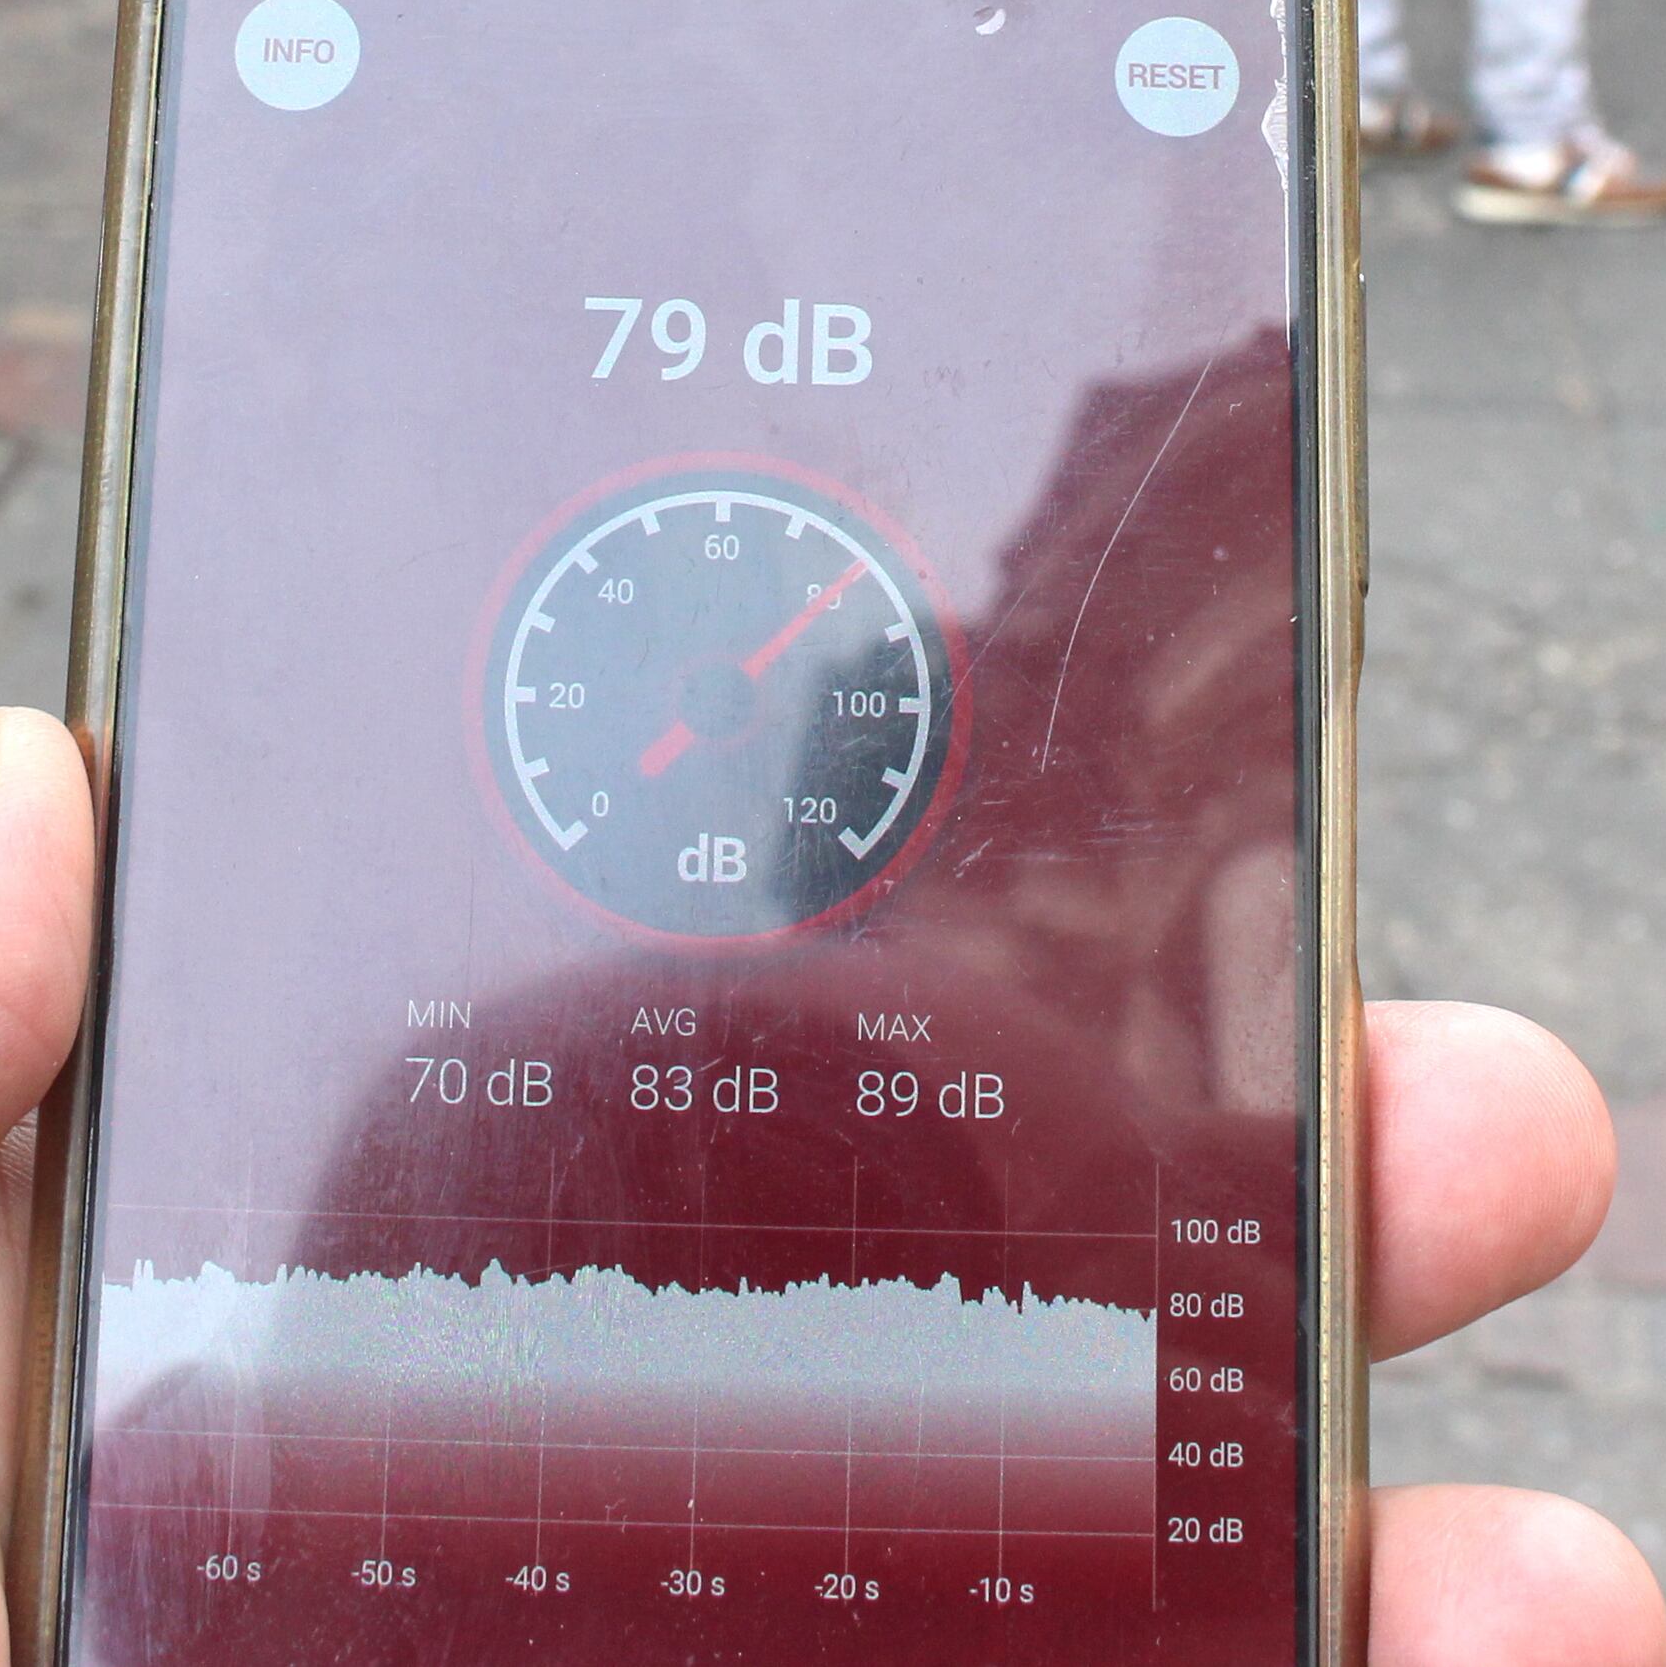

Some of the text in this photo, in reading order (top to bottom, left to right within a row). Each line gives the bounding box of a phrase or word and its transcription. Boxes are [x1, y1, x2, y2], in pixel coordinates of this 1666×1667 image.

[263, 37, 335, 65] INFO
[1127, 62, 1226, 90] RESET
[583, 296, 874, 387] 79 dB
[703, 534, 741, 561] 60
[597, 577, 635, 606] 40
[547, 682, 586, 710] 20
[831, 690, 887, 719] 100
[590, 791, 610, 818] 0
[782, 796, 838, 824] 120
[677, 833, 748, 884] dB
[406, 999, 472, 1030] MIN
[630, 1006, 697, 1037] AVG
[856, 1012, 932, 1043] MAX
[404, 1056, 555, 1107] 70 dB
[630, 1063, 779, 1114] 83 dB
[854, 1069, 1006, 1120] 89 dB
[1170, 1218, 1262, 1245] 100 dB
[1169, 1292, 1245, 1318] 80 dB
[1169, 1366, 1245, 1393] 60 dB
[1167, 1441, 1245, 1468] 40 dB
[1167, 1516, 1244, 1543] 20 dB
[196, 1554, 262, 1582] -60 s
[350, 1559, 417, 1588] -50 s
[504, 1564, 571, 1593] -40 s
[659, 1569, 726, 1597] -30 s
[813, 1573, 880, 1601] -20 s
[968, 1576, 1035, 1604] -10 s
